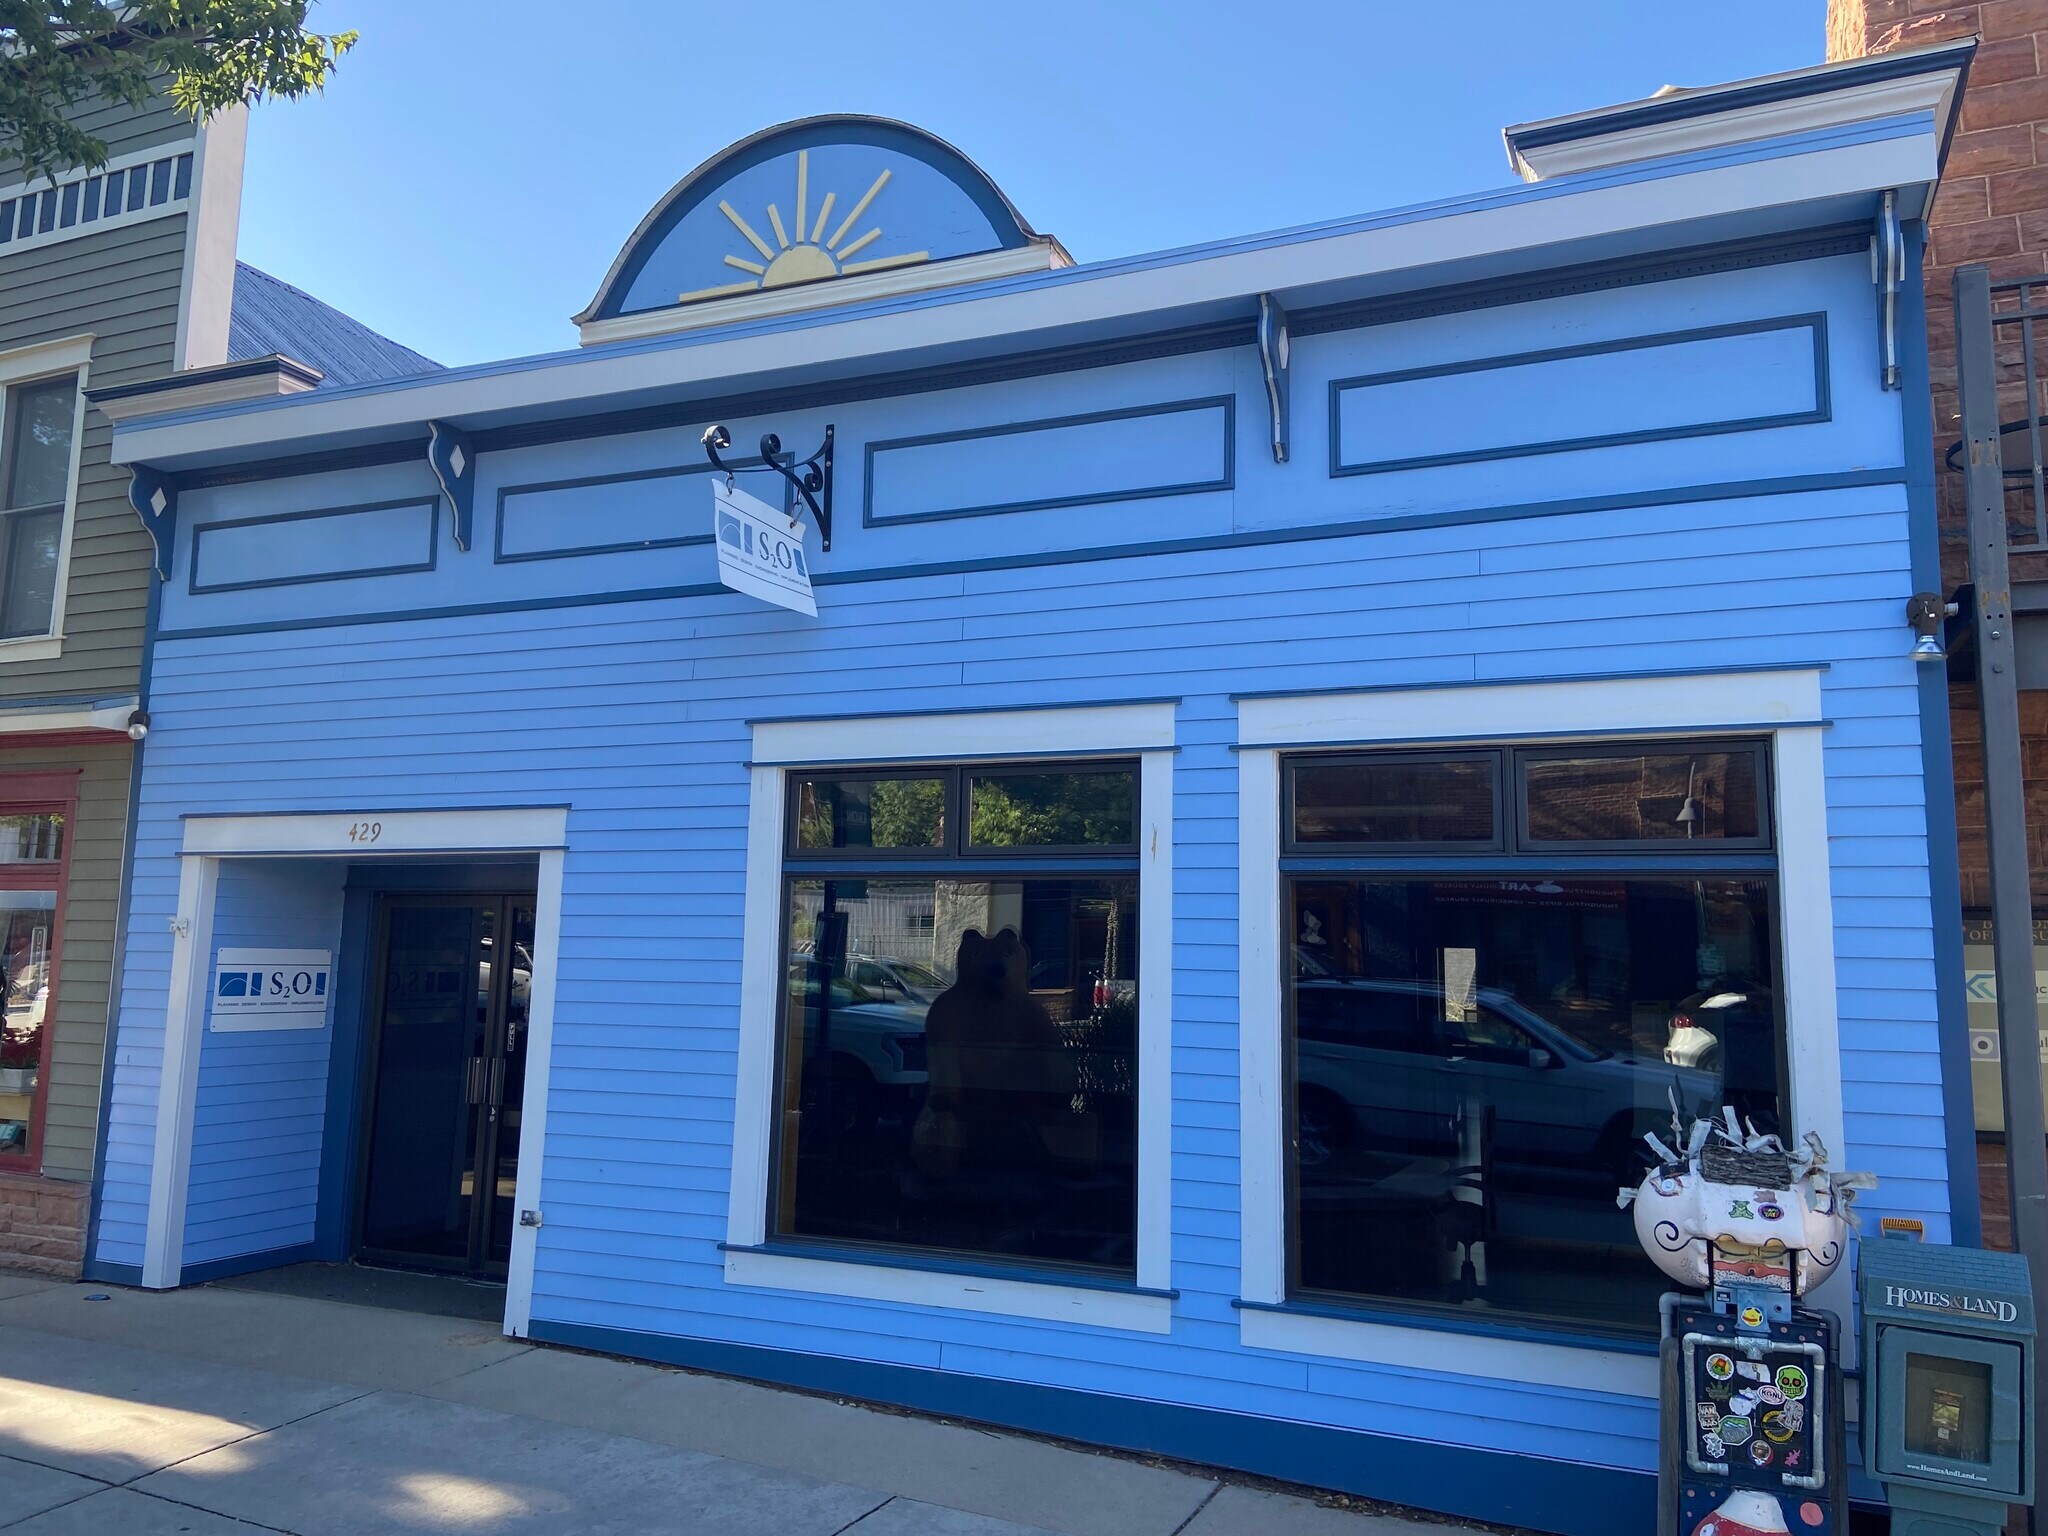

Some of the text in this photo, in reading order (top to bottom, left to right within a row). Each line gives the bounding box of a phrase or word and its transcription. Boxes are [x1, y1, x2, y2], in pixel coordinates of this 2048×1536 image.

[349, 822, 382, 844] 429
[1761, 1389, 1783, 1400] KGNU
[1906, 1464, 1988, 1482] www.HomesAndLand.com
